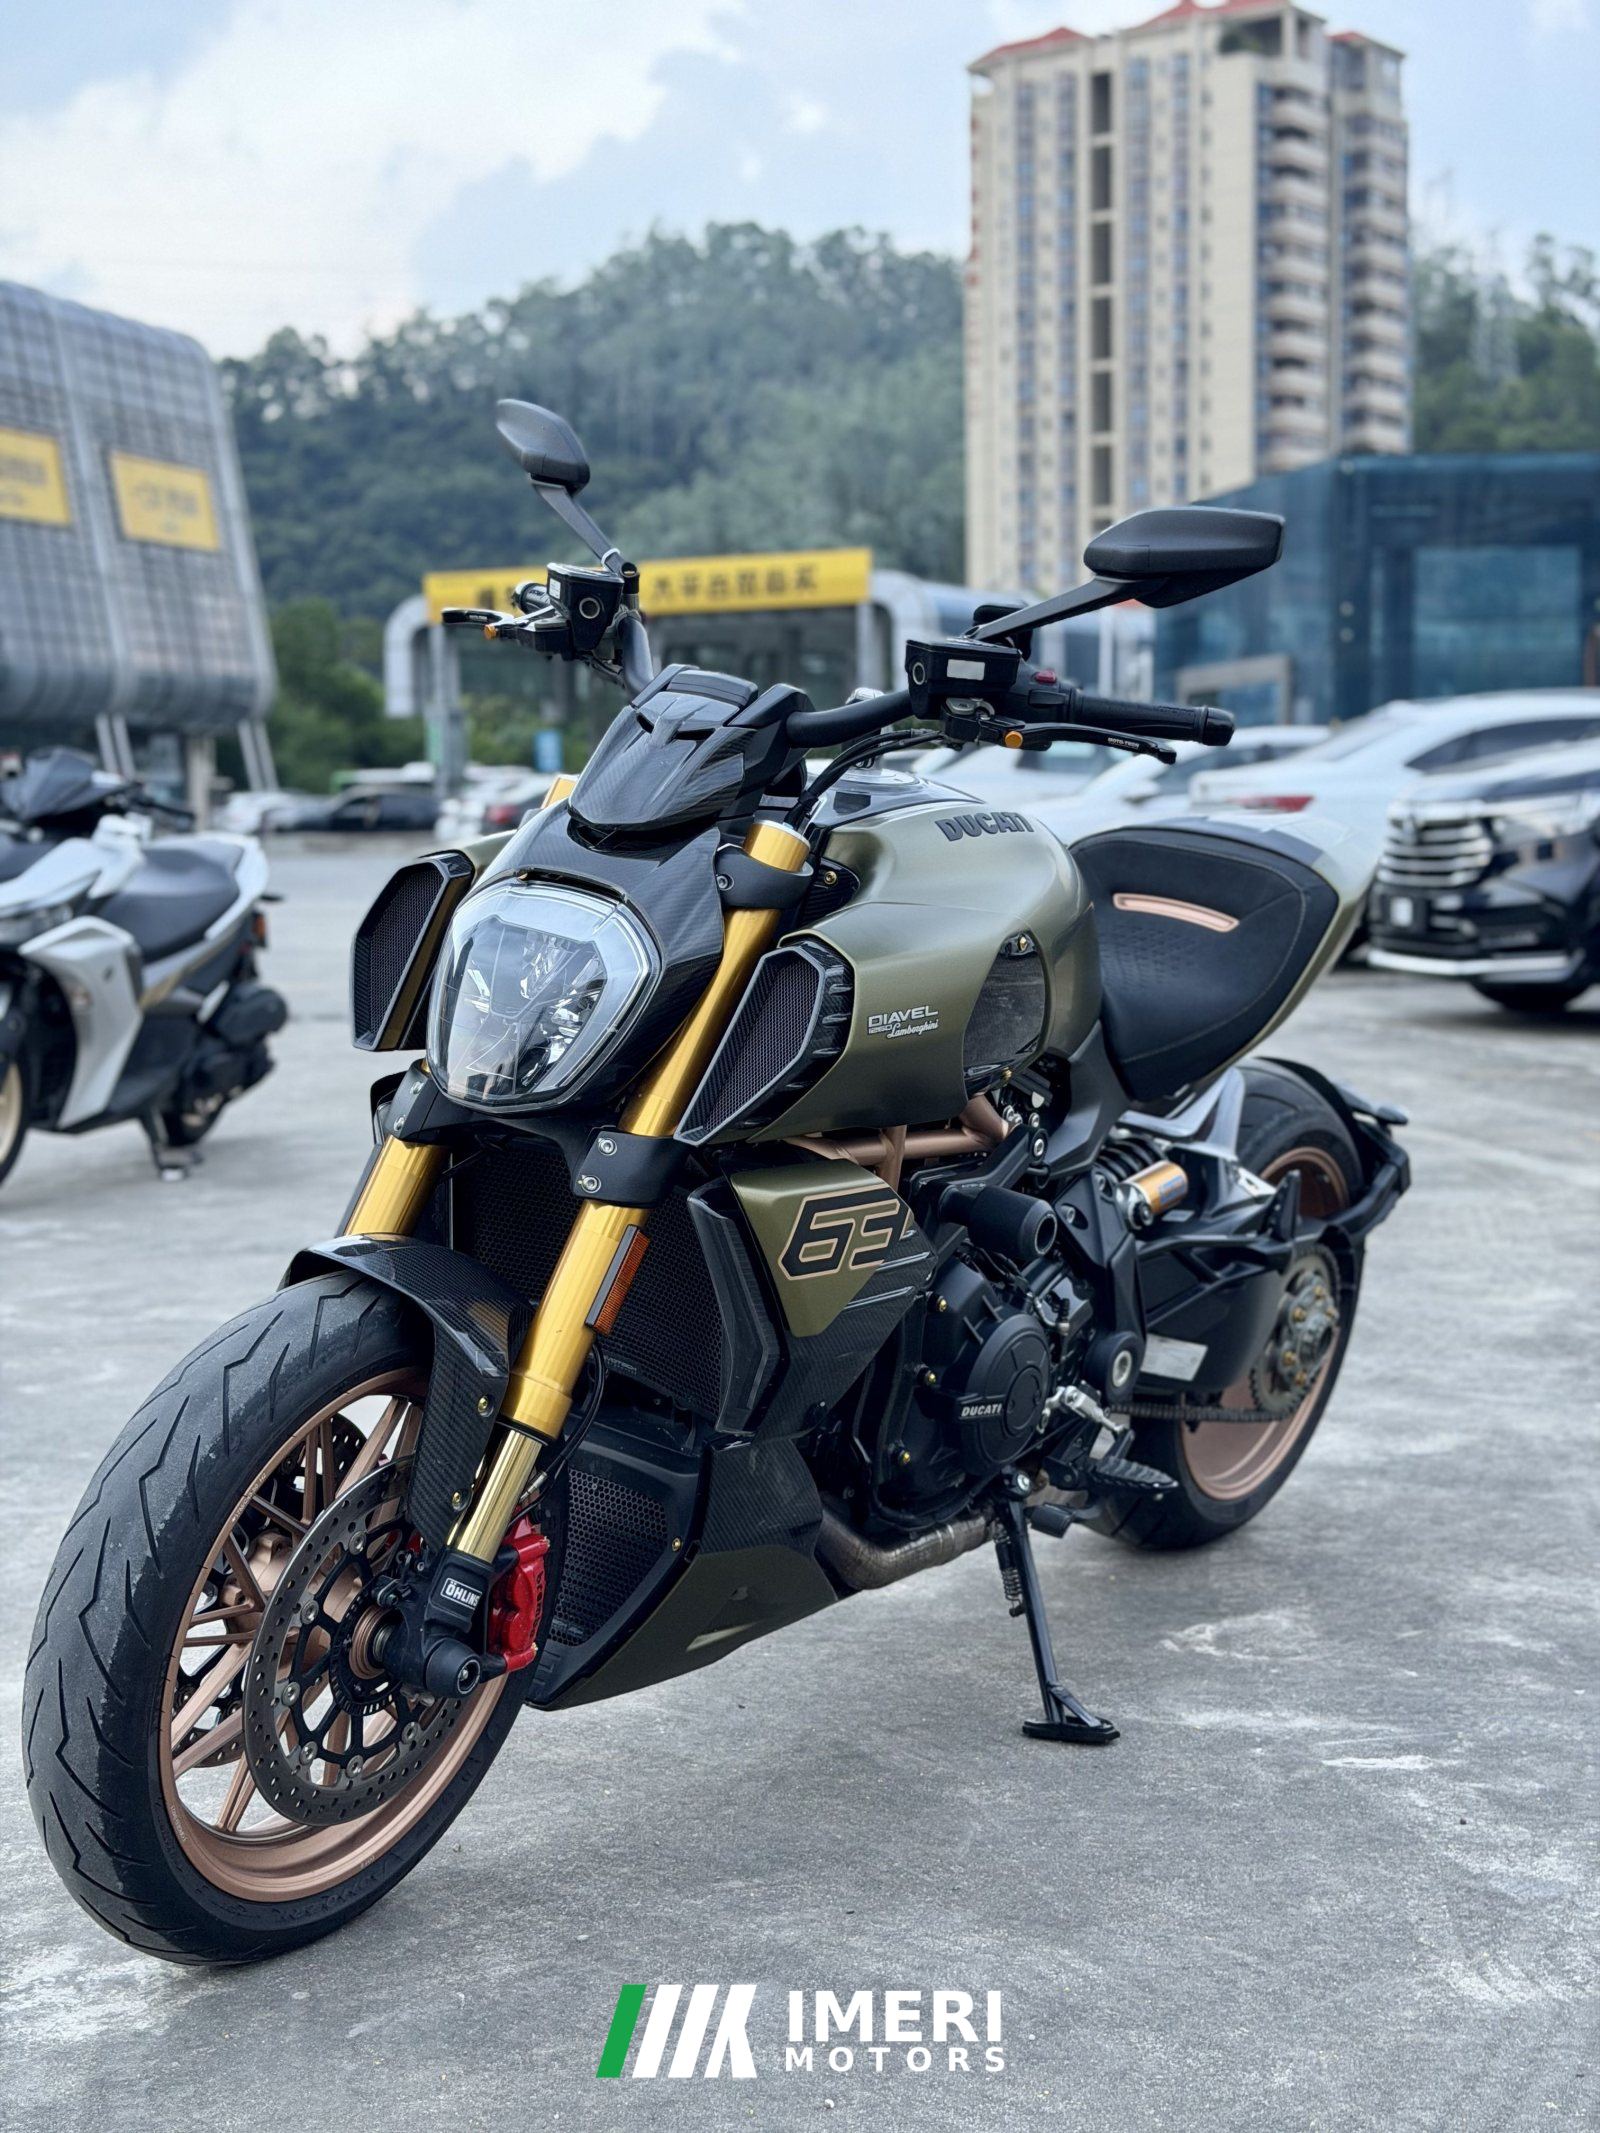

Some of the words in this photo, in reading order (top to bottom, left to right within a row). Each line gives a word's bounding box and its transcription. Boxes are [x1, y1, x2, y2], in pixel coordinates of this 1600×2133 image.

[934, 811, 1035, 842] DUCATI
[868, 1005, 939, 1027] DIAVEL
[886, 1019, 939, 1039] Lamborghini
[778, 1183, 911, 1280] 63
[961, 1403, 1003, 1417] DUCATI
[445, 1580, 481, 1607] ÖHLINS
